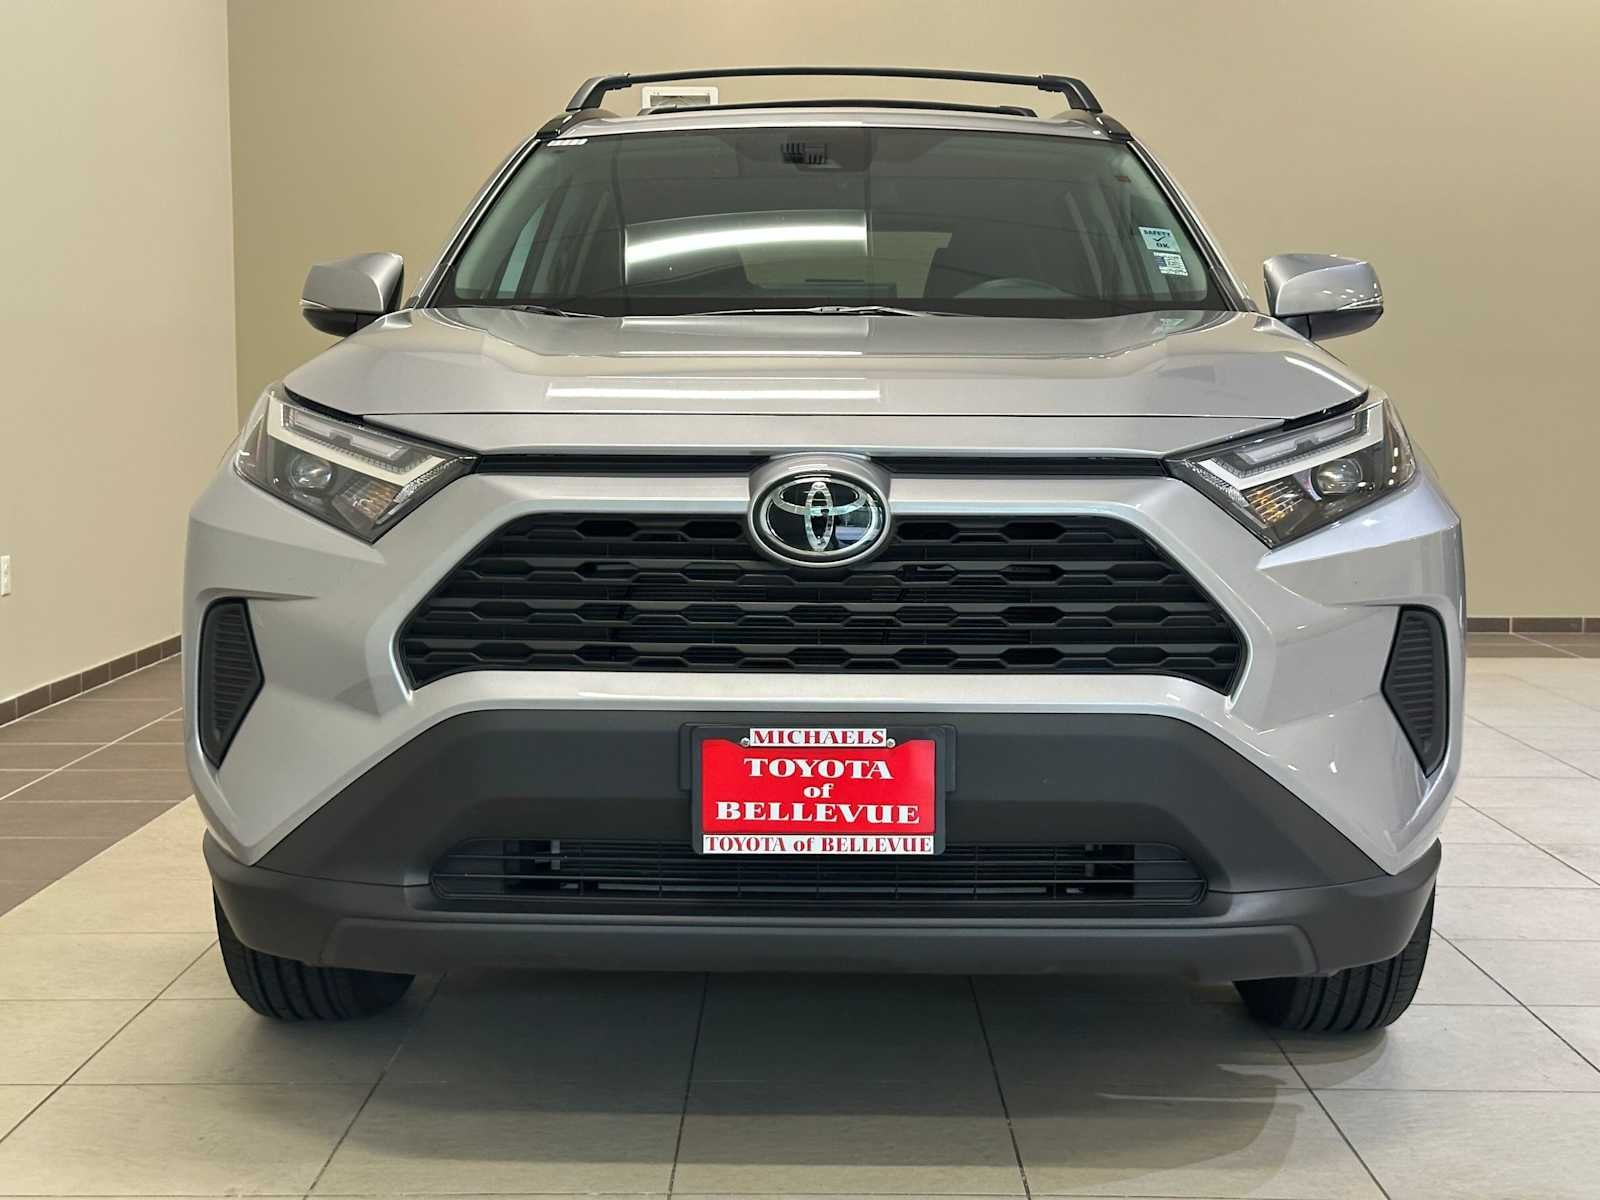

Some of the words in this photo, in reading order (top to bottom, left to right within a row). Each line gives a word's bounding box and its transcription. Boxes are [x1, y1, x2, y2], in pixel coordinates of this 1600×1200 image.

[753, 729, 884, 744] MICHAELS
[743, 757, 894, 780] TOYOTA
[802, 783, 835, 799] of
[715, 801, 920, 824] BELLEVUE
[705, 837, 786, 852] TOYOTA
[793, 837, 815, 852] of
[822, 837, 932, 853] BELLEVUE
